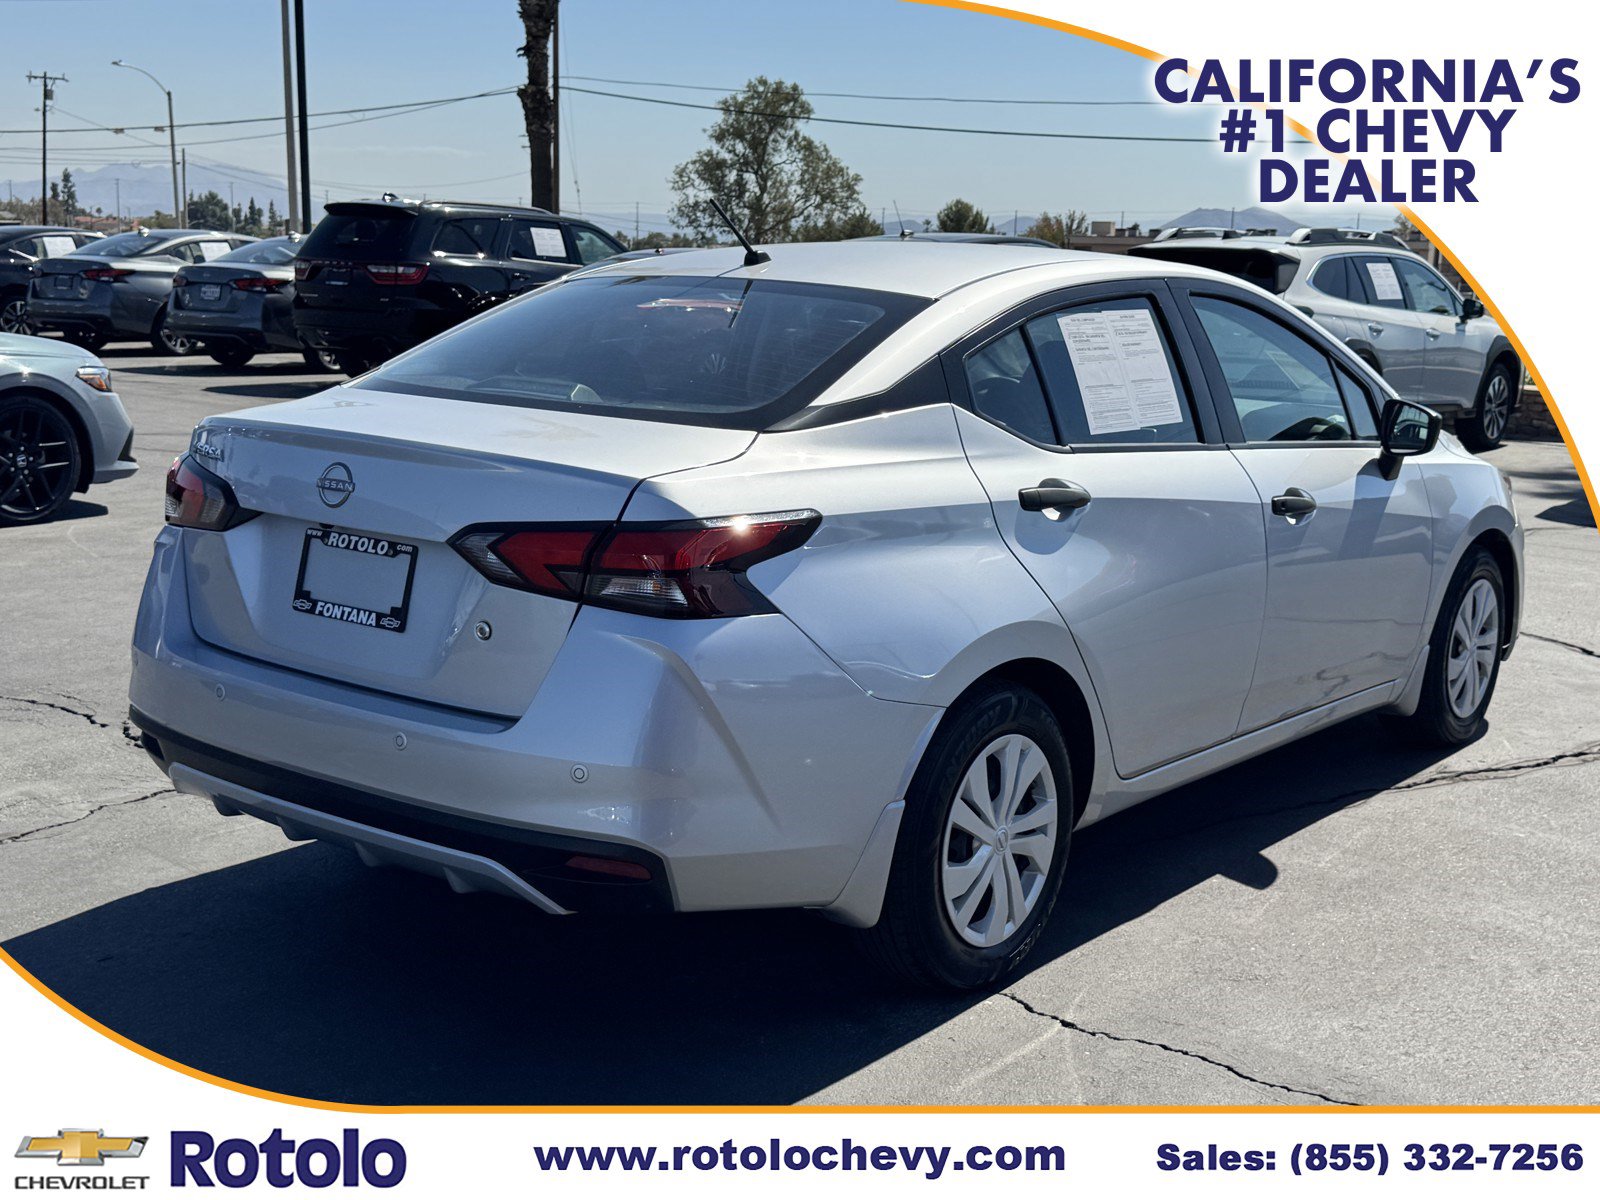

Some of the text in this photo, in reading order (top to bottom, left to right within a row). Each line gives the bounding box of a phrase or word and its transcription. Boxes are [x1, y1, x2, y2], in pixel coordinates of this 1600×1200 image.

[317, 478, 353, 492] NISSAN
[327, 532, 389, 555] ROTOLO
[315, 602, 377, 627] FONTANA
